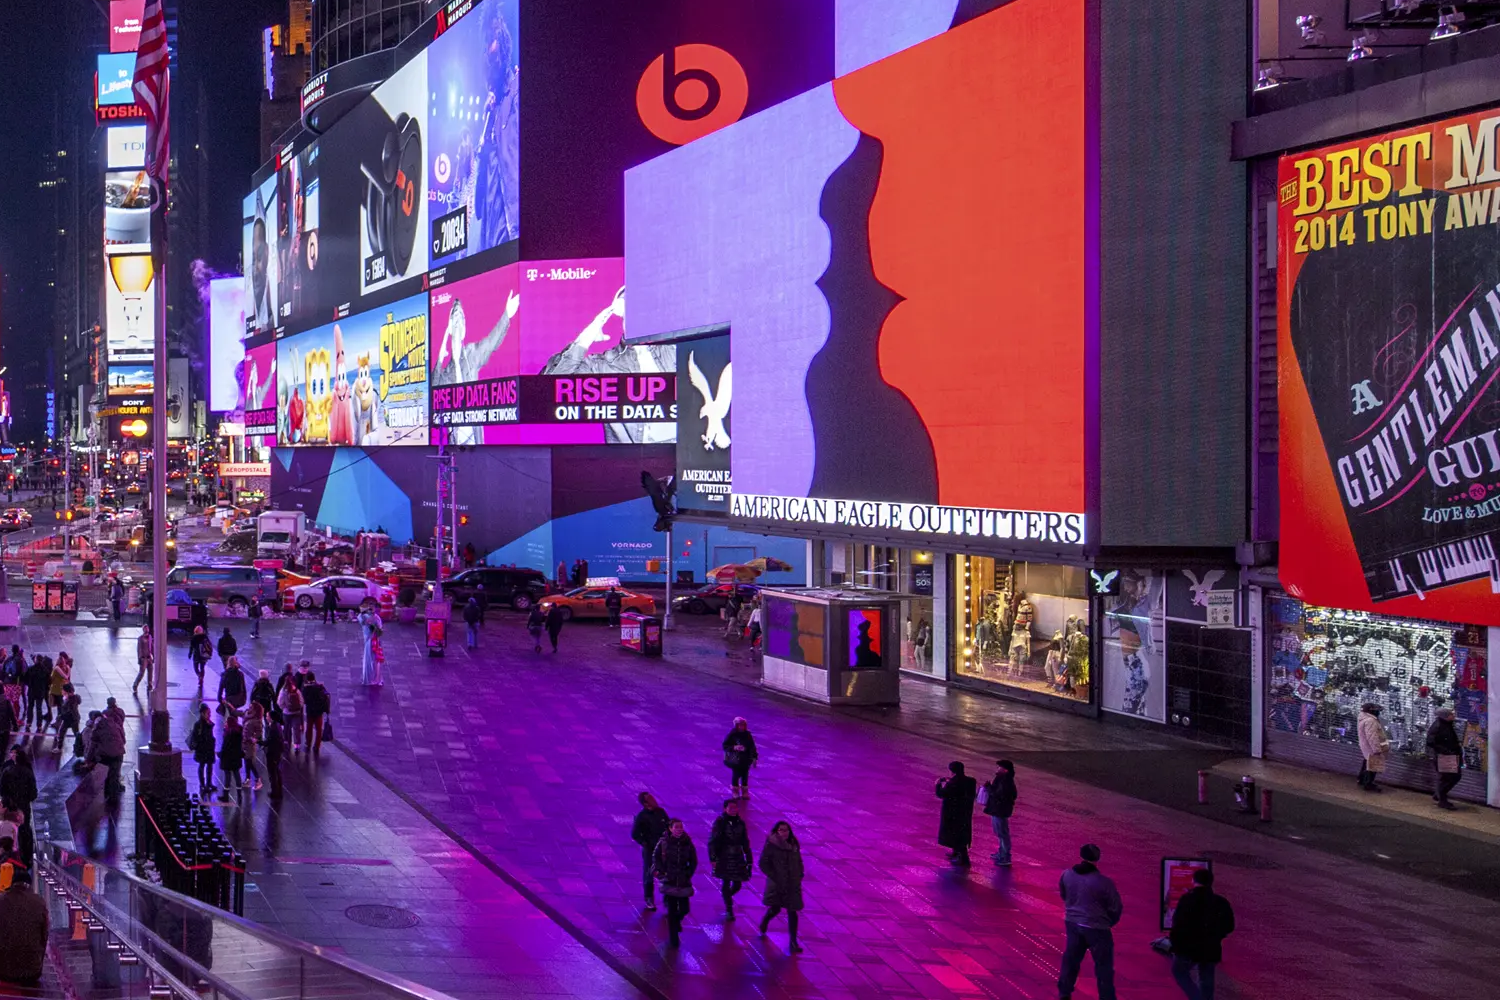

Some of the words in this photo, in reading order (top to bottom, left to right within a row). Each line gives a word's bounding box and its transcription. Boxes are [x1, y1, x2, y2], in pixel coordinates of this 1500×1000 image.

[118, 69, 127, 79] to
[1280, 181, 1297, 204] THE
[1293, 132, 1431, 217] BEST
[1294, 211, 1356, 253] 2014
[1363, 198, 1437, 242] TONY
[433, 387, 451, 410] RISE
[452, 385, 465, 409] UP
[466, 383, 489, 408] DATA
[491, 380, 517, 405] FANS
[556, 378, 618, 403] RISE
[626, 376, 666, 402] UP
[1350, 379, 1383, 416] A
[452, 411, 464, 423] DATA
[488, 407, 517, 422] NETWORK
[555, 406, 580, 420] ON
[584, 405, 618, 419] THE
[622, 405, 665, 419] DATA
[682, 470, 724, 481] AMERICAN
[732, 493, 828, 525] AMERICAN
[835, 499, 902, 529] EAGLE
[908, 505, 1083, 544] OUTFITTERS
[1421, 507, 1463, 524] LOVE
